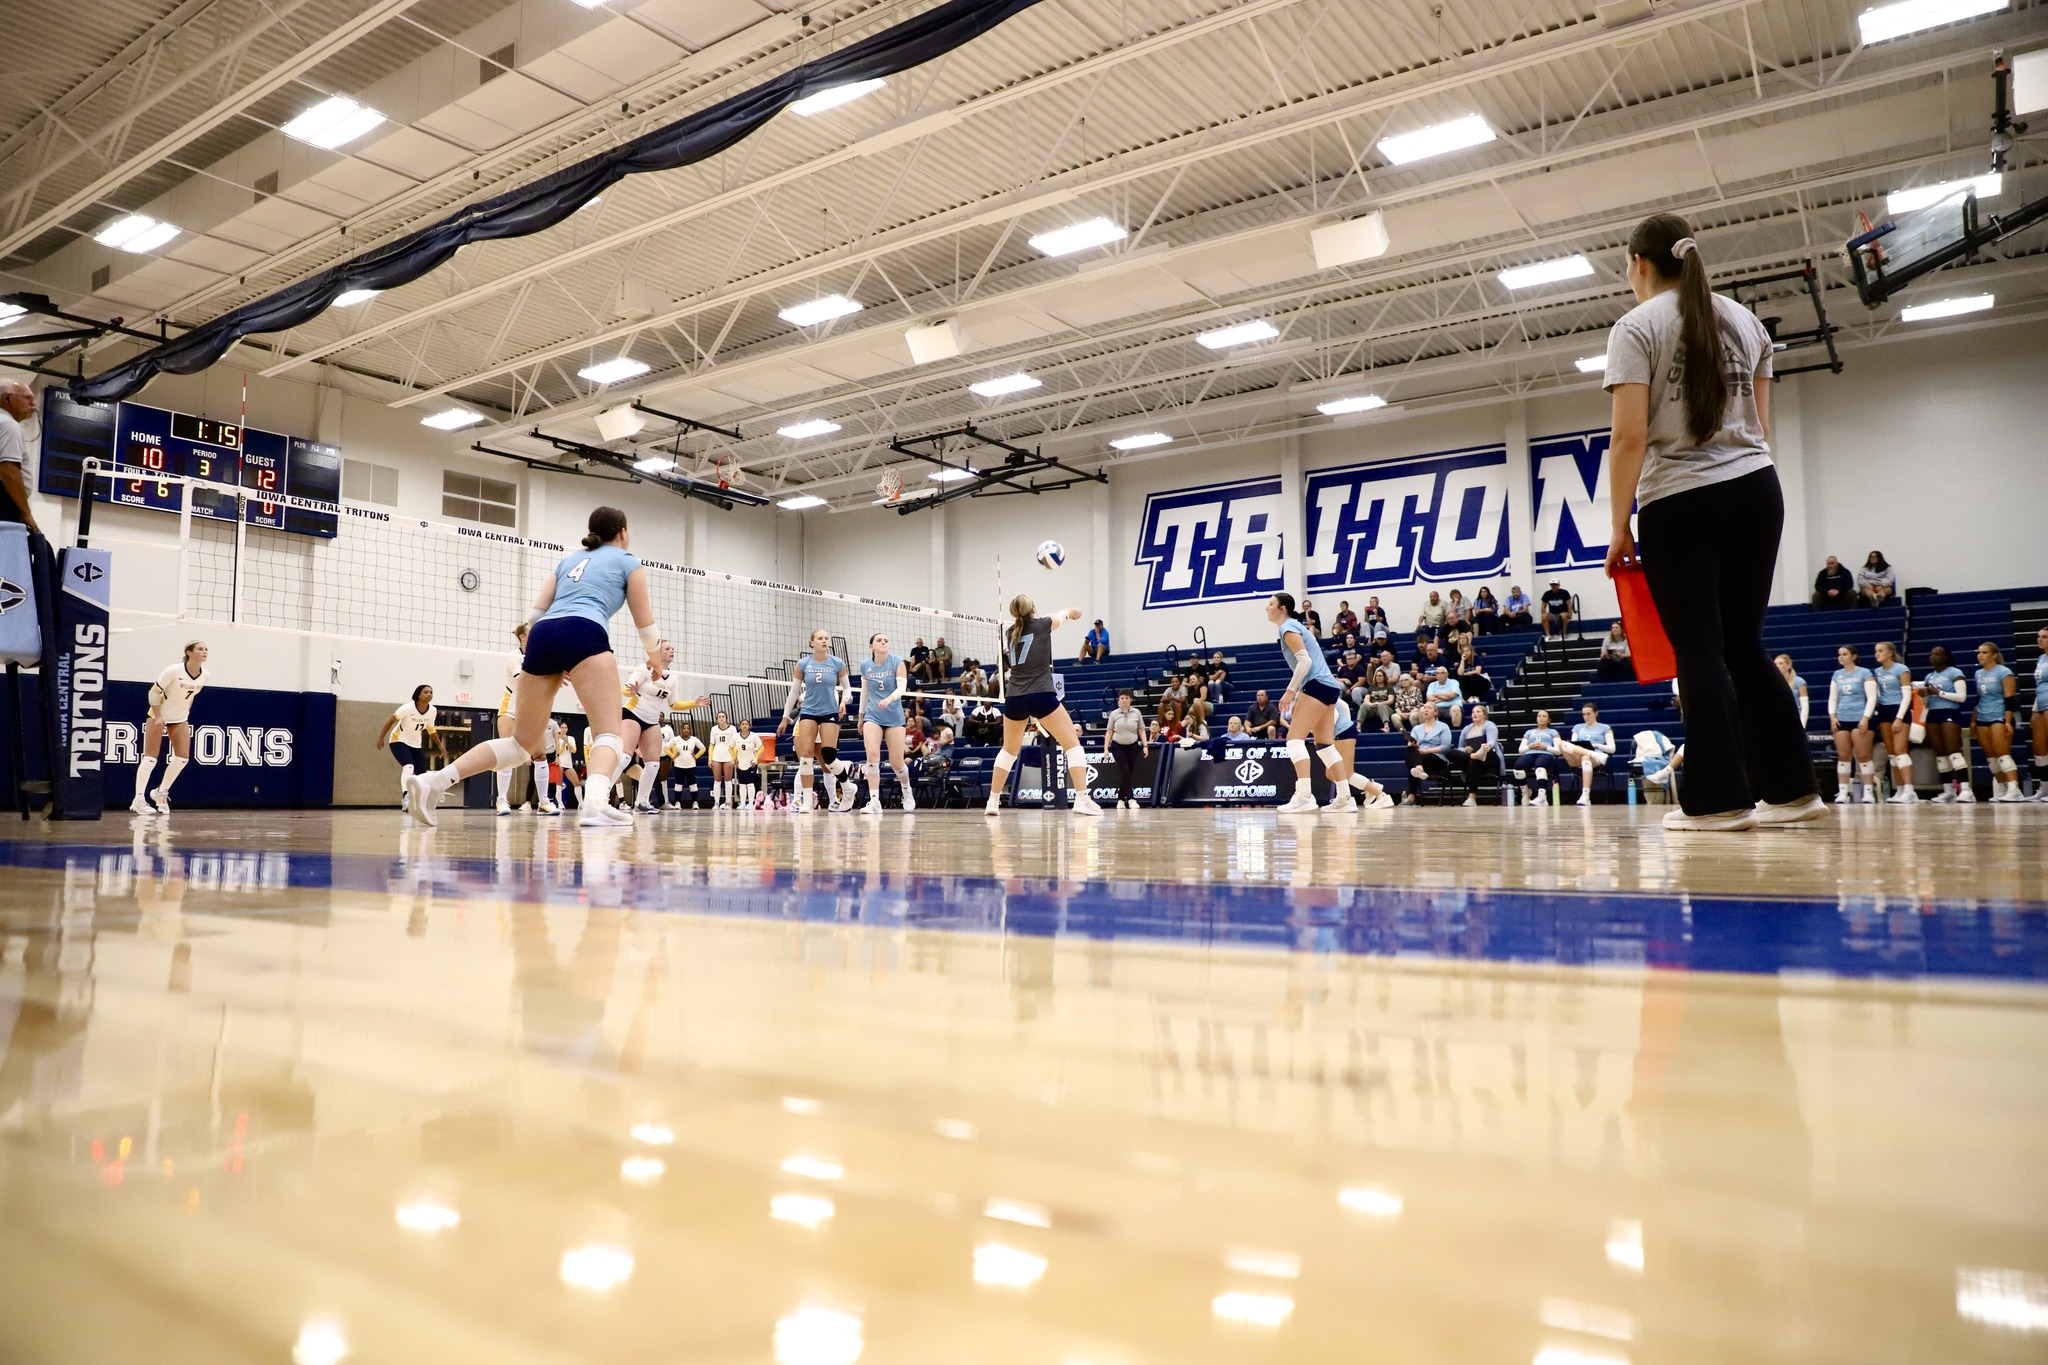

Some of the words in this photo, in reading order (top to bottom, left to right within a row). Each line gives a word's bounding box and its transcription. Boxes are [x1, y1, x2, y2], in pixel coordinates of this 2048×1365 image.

[130, 431, 162, 445] HOME
[198, 421, 236, 446] 1:15
[192, 448, 217, 459] PERIOD
[294, 441, 307, 449] PLYR
[143, 447, 162, 469] 10
[245, 453, 275, 468] GUEST
[200, 459, 210, 476] 3
[257, 469, 275, 490] 12
[158, 480, 168, 497] 6
[121, 493, 145, 505] SCORE
[256, 490, 287, 504] IOWA
[290, 496, 341, 513] CENTRAL
[344, 506, 390, 522] TRITONS
[191, 505, 214, 516] MATCH
[255, 515, 276, 526] SCORE
[1145, 434, 1612, 607] TRITON
[458, 527, 482, 538] IOWA
[485, 531, 525, 546] CENTRAL
[528, 539, 564, 552] TRITONS
[567, 557, 592, 584] 4
[640, 559, 674, 571] CENTRAL
[676, 565, 706, 577] TRITONS
[750, 578, 767, 587] IOWA
[768, 581, 796, 592] CENTRAL
[798, 585, 823, 596] TRITONS
[875, 599, 899, 609] CENTRAL
[900, 603, 921, 613] TRITONS
[1008, 633, 1034, 667] 17
[57, 652, 70, 711] CENTRAL
[815, 673, 823, 683] 2
[877, 680, 885, 691] 3
[69, 624, 106, 777] TRITONS
[185, 691, 195, 700] 7
[656, 689, 669, 699] 15
[104, 721, 294, 767] RONS
[1246, 747, 1267, 759] OF
[1270, 747, 1292, 759] TH
[1056, 745, 1065, 789] TONS
[1214, 784, 1277, 798] TRITONS
